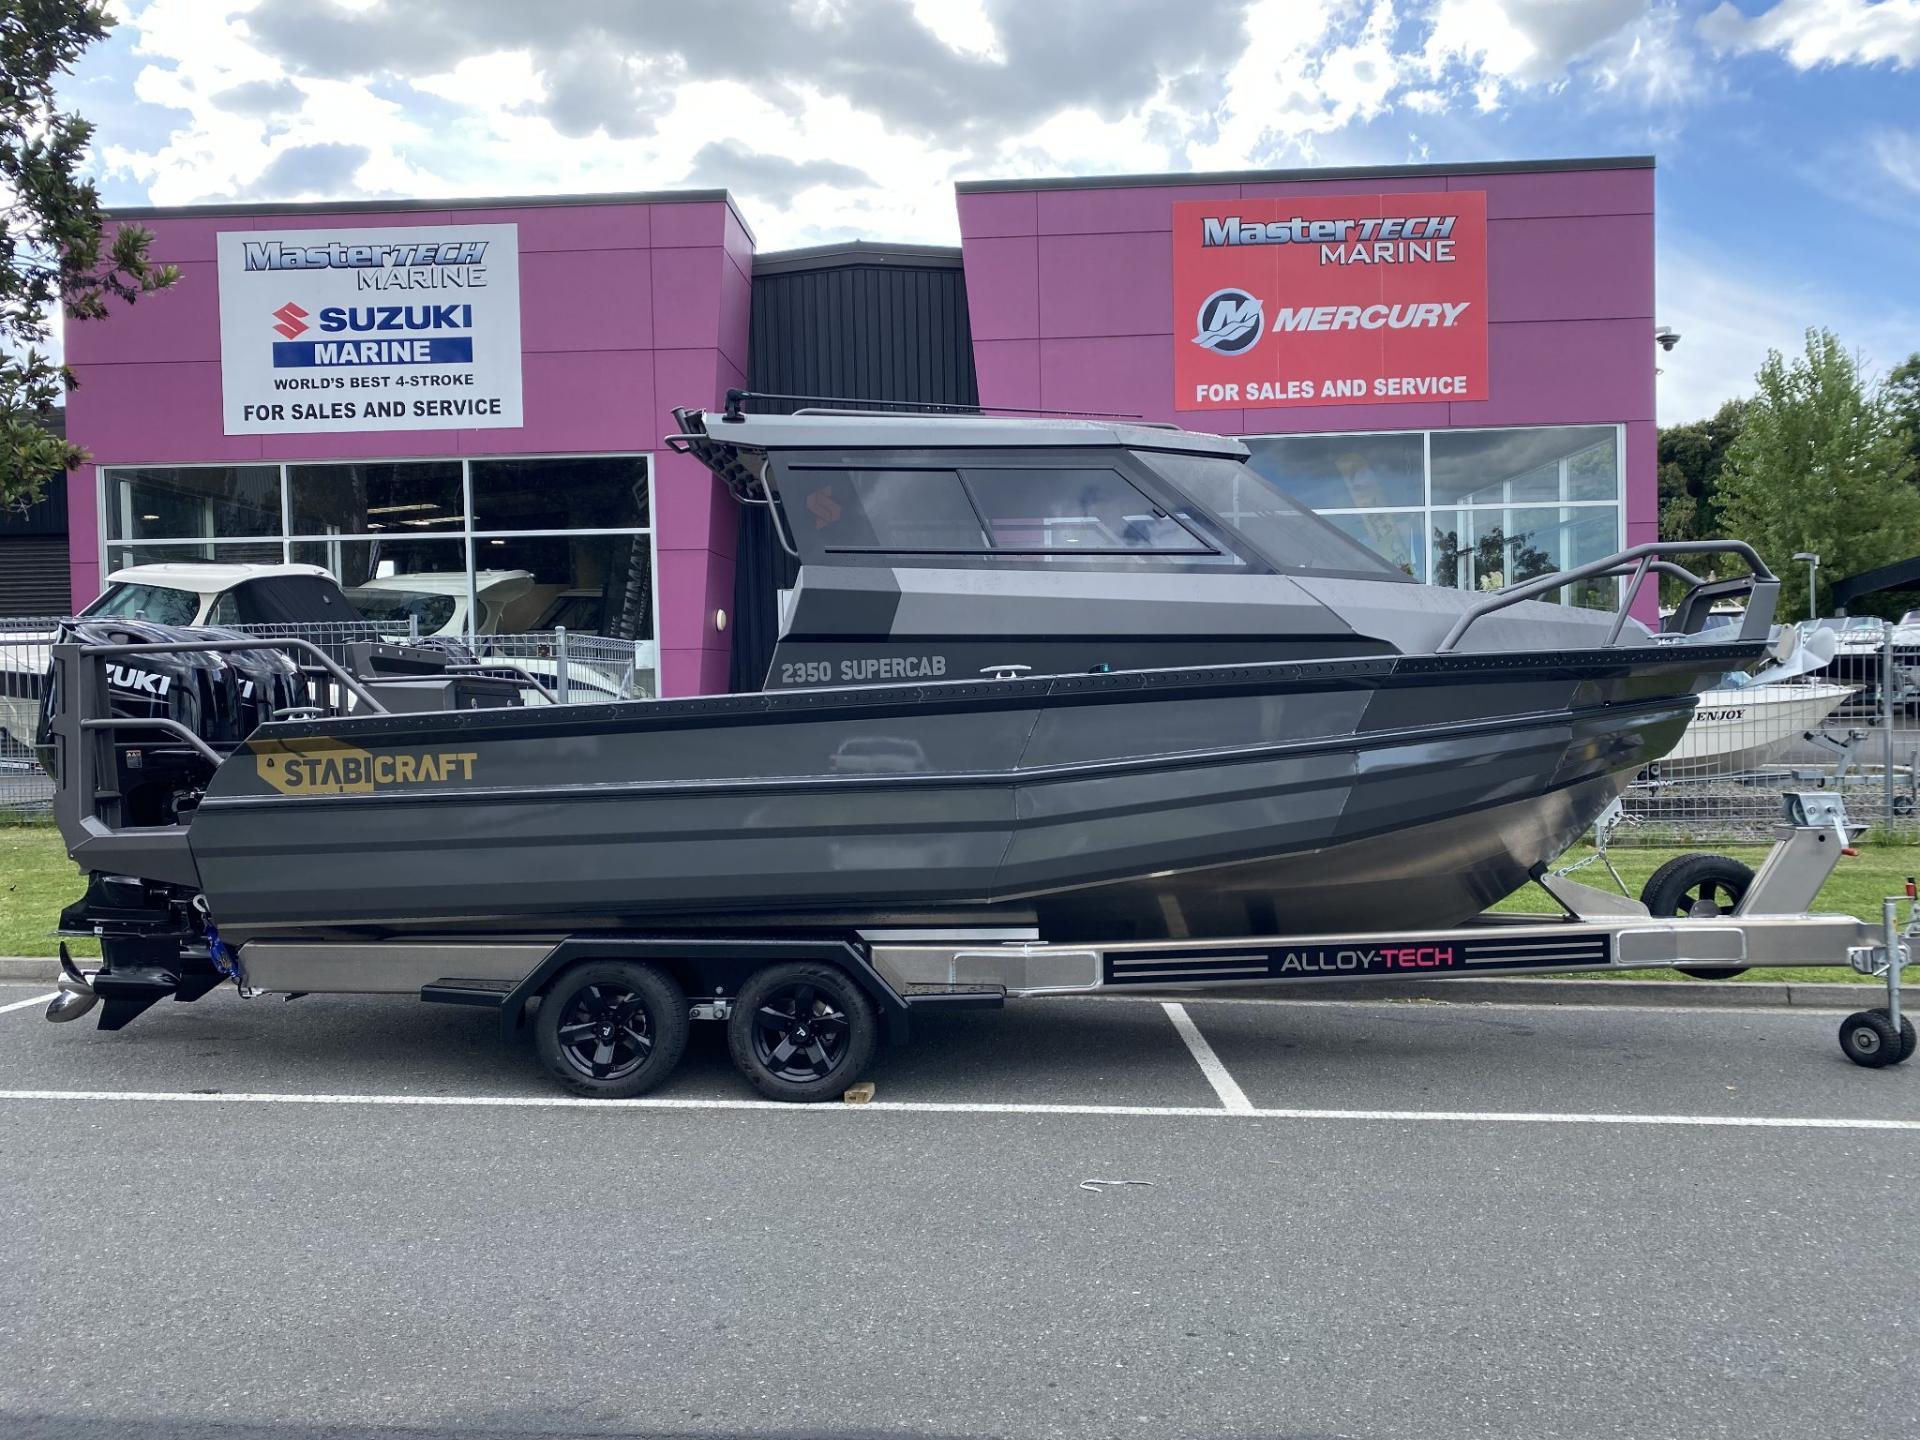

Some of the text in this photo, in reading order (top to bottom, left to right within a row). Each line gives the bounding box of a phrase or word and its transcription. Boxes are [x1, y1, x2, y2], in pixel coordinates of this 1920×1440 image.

[1320, 241, 1456, 266] MARINE
[357, 265, 488, 291] MARINE
[319, 304, 472, 332] SUZUKI
[1272, 302, 1471, 332] MERCURY
[314, 340, 431, 365] MARINE
[274, 374, 474, 391] WORLD'S BEST 4-STROKE
[1196, 376, 1467, 402] FOR SALES AND SERVICE
[243, 398, 501, 421] FOR SALES AND SERVICE
[782, 655, 946, 683] 2350 SUPERCAB
[1697, 709, 1746, 721] ENJOY
[284, 752, 478, 787] STABICRAFT
[1281, 947, 1453, 972] ALLOY-TECH
